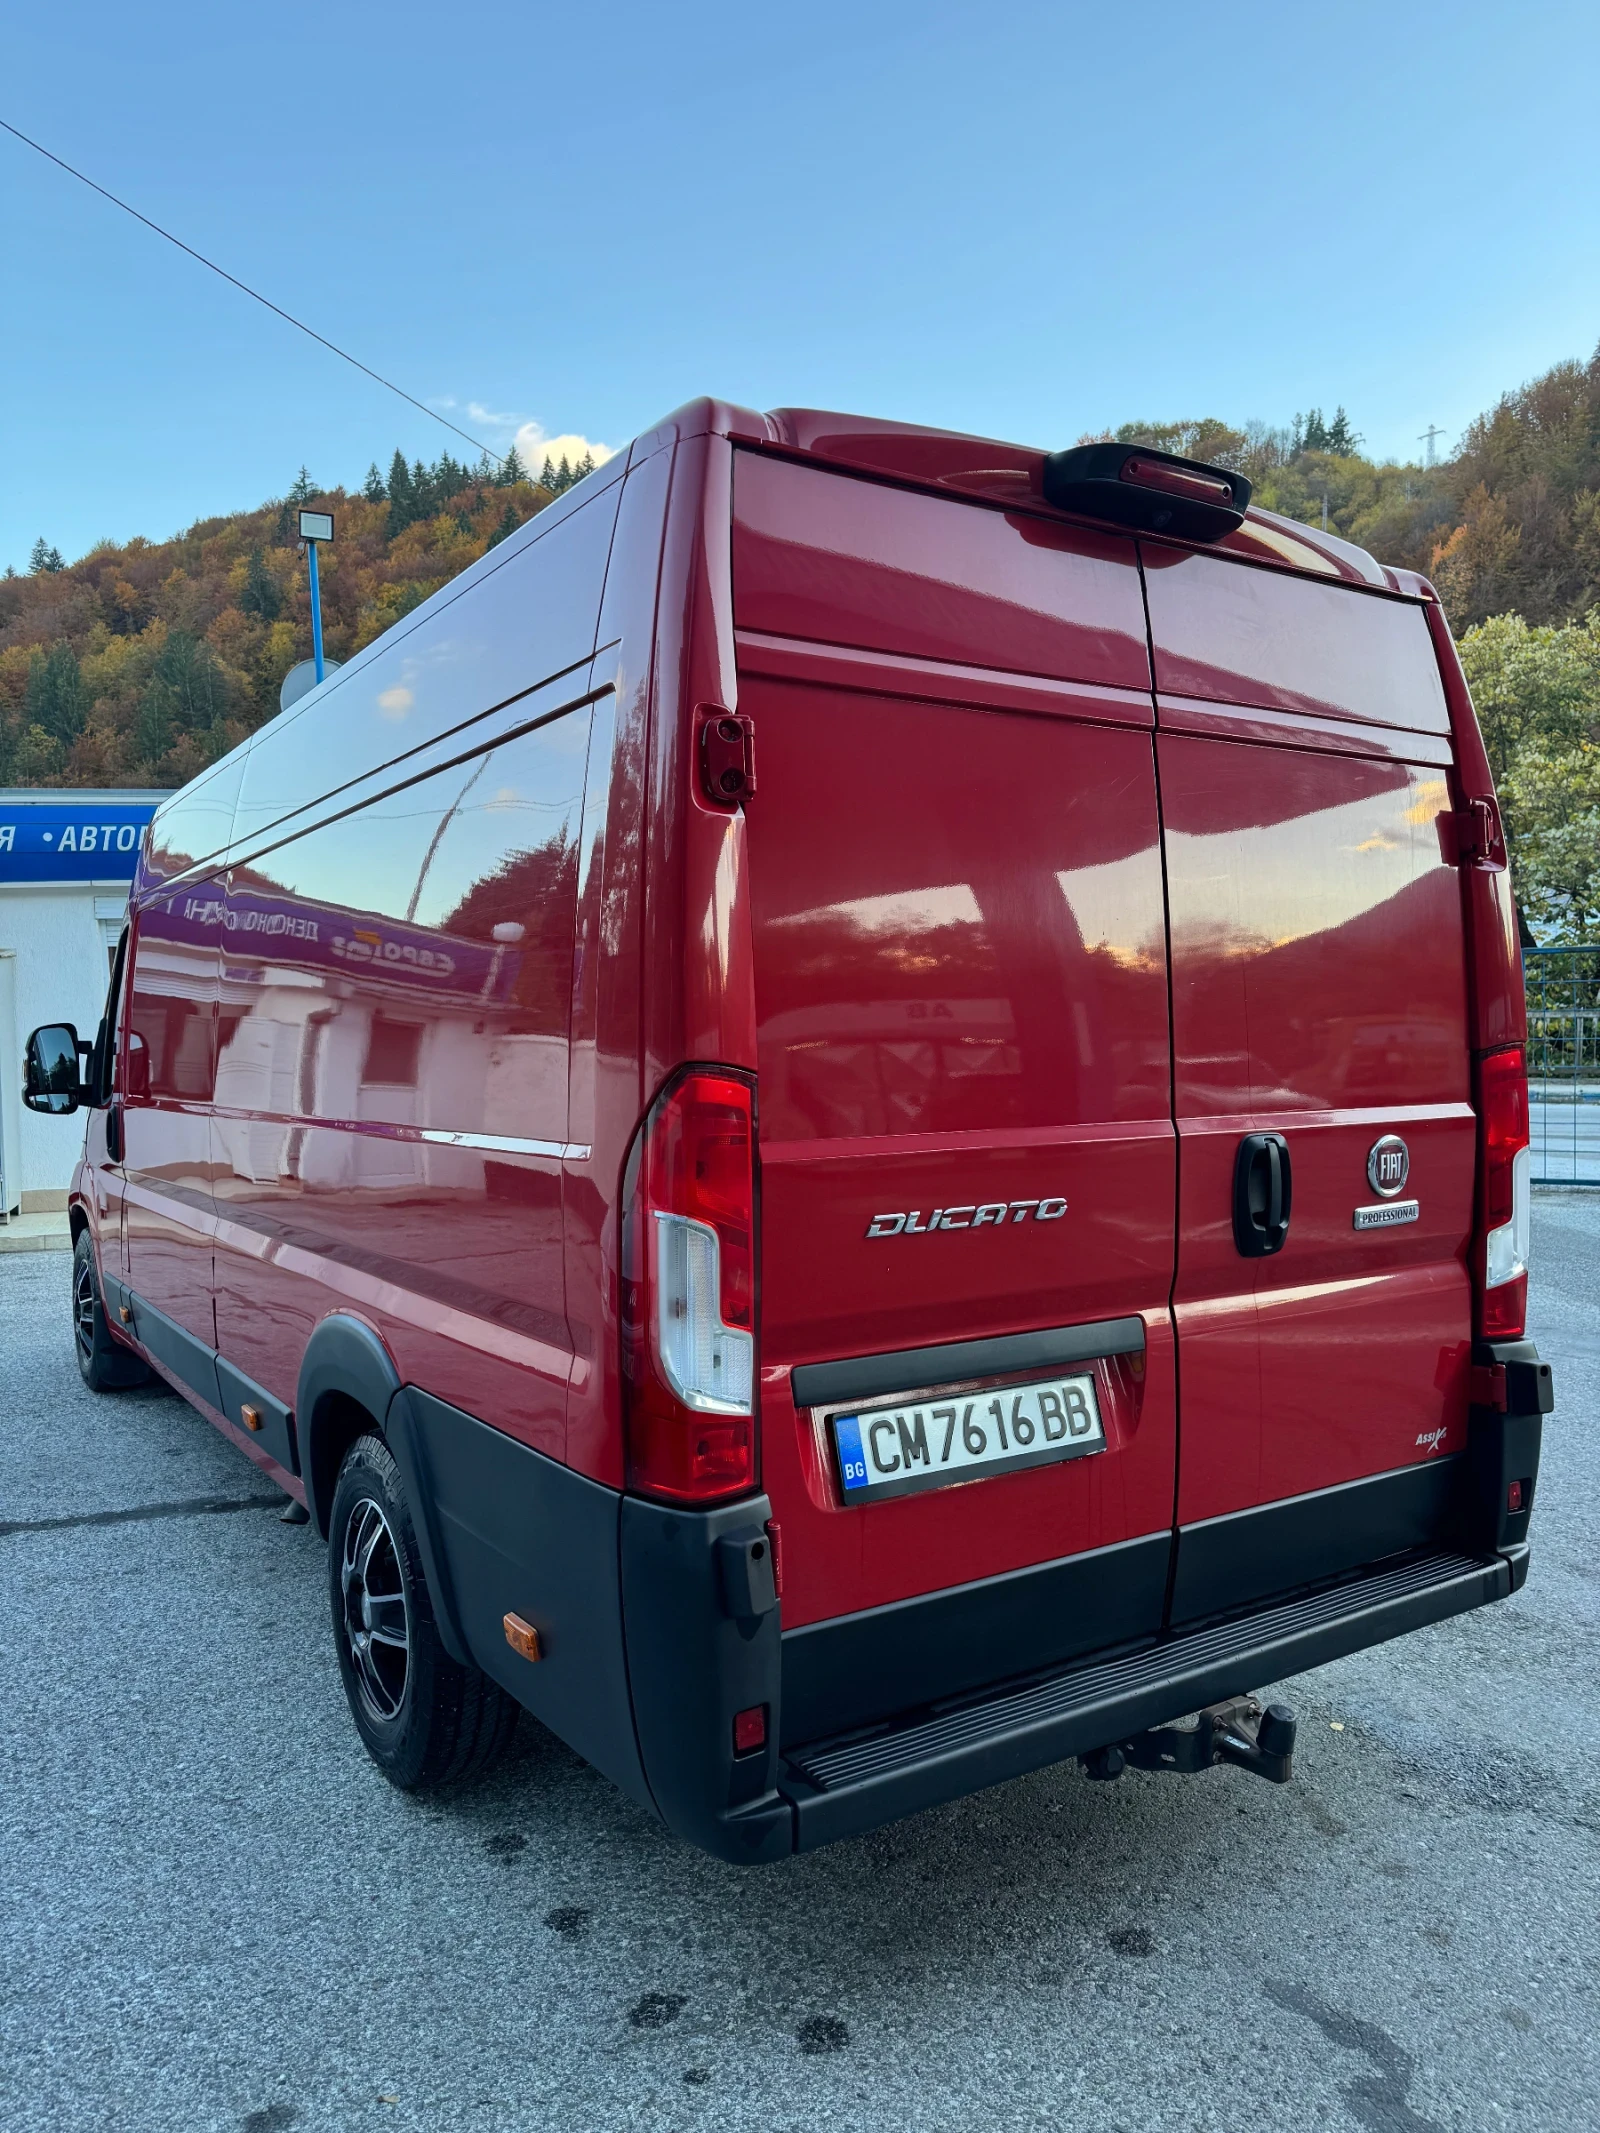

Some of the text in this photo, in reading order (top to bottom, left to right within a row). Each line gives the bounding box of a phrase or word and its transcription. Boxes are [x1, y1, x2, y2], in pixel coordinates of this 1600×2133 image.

[1380, 1152, 1403, 1180] FIAT
[865, 1198, 1067, 1238] DUCATO
[1362, 1206, 1417, 1225] PROFESSIONAL
[845, 1462, 865, 1480] BG
